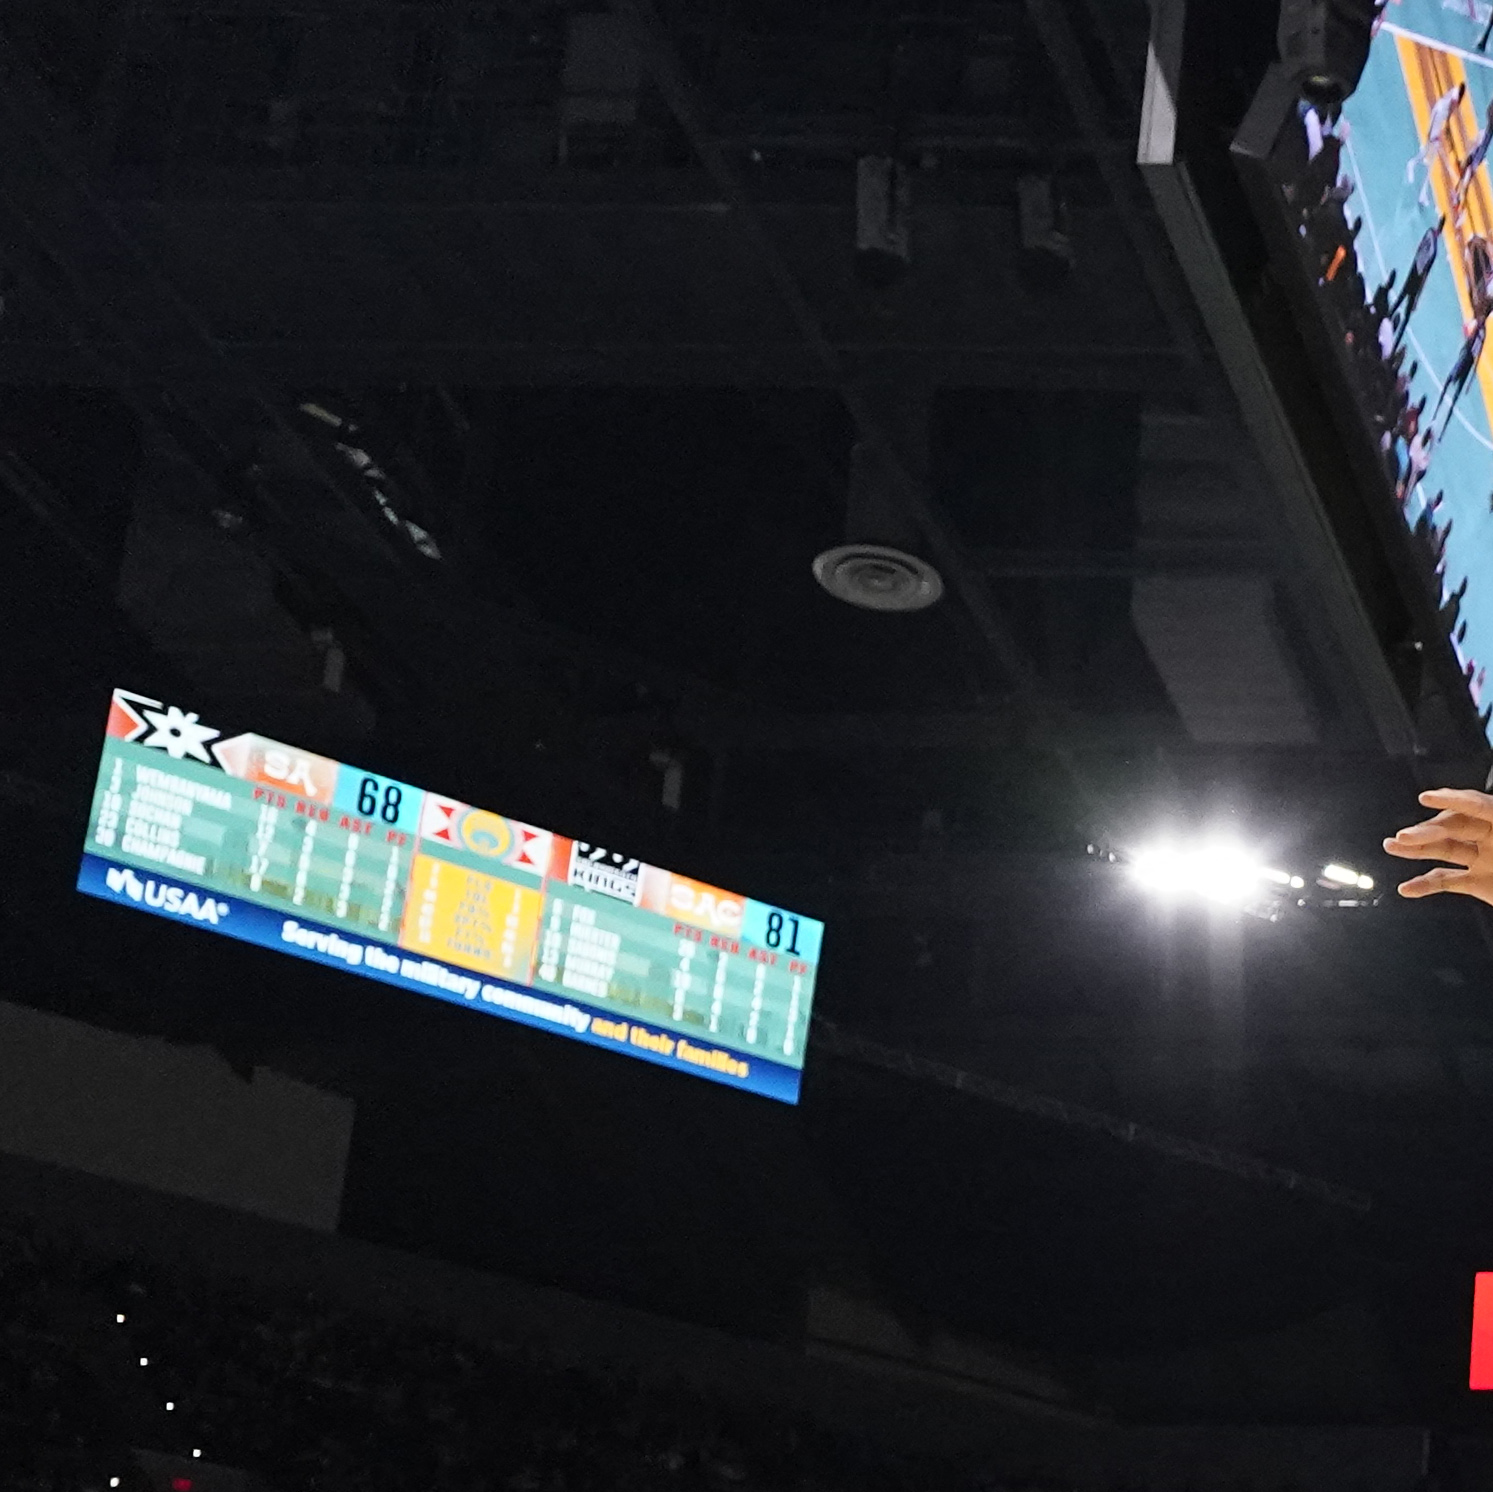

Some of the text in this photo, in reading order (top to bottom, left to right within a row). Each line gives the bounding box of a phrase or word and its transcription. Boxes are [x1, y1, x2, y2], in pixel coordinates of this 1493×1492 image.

[264, 751, 317, 797] SA
[357, 777, 403, 824] 68
[670, 884, 741, 926] SAC
[766, 912, 800, 956] 81
